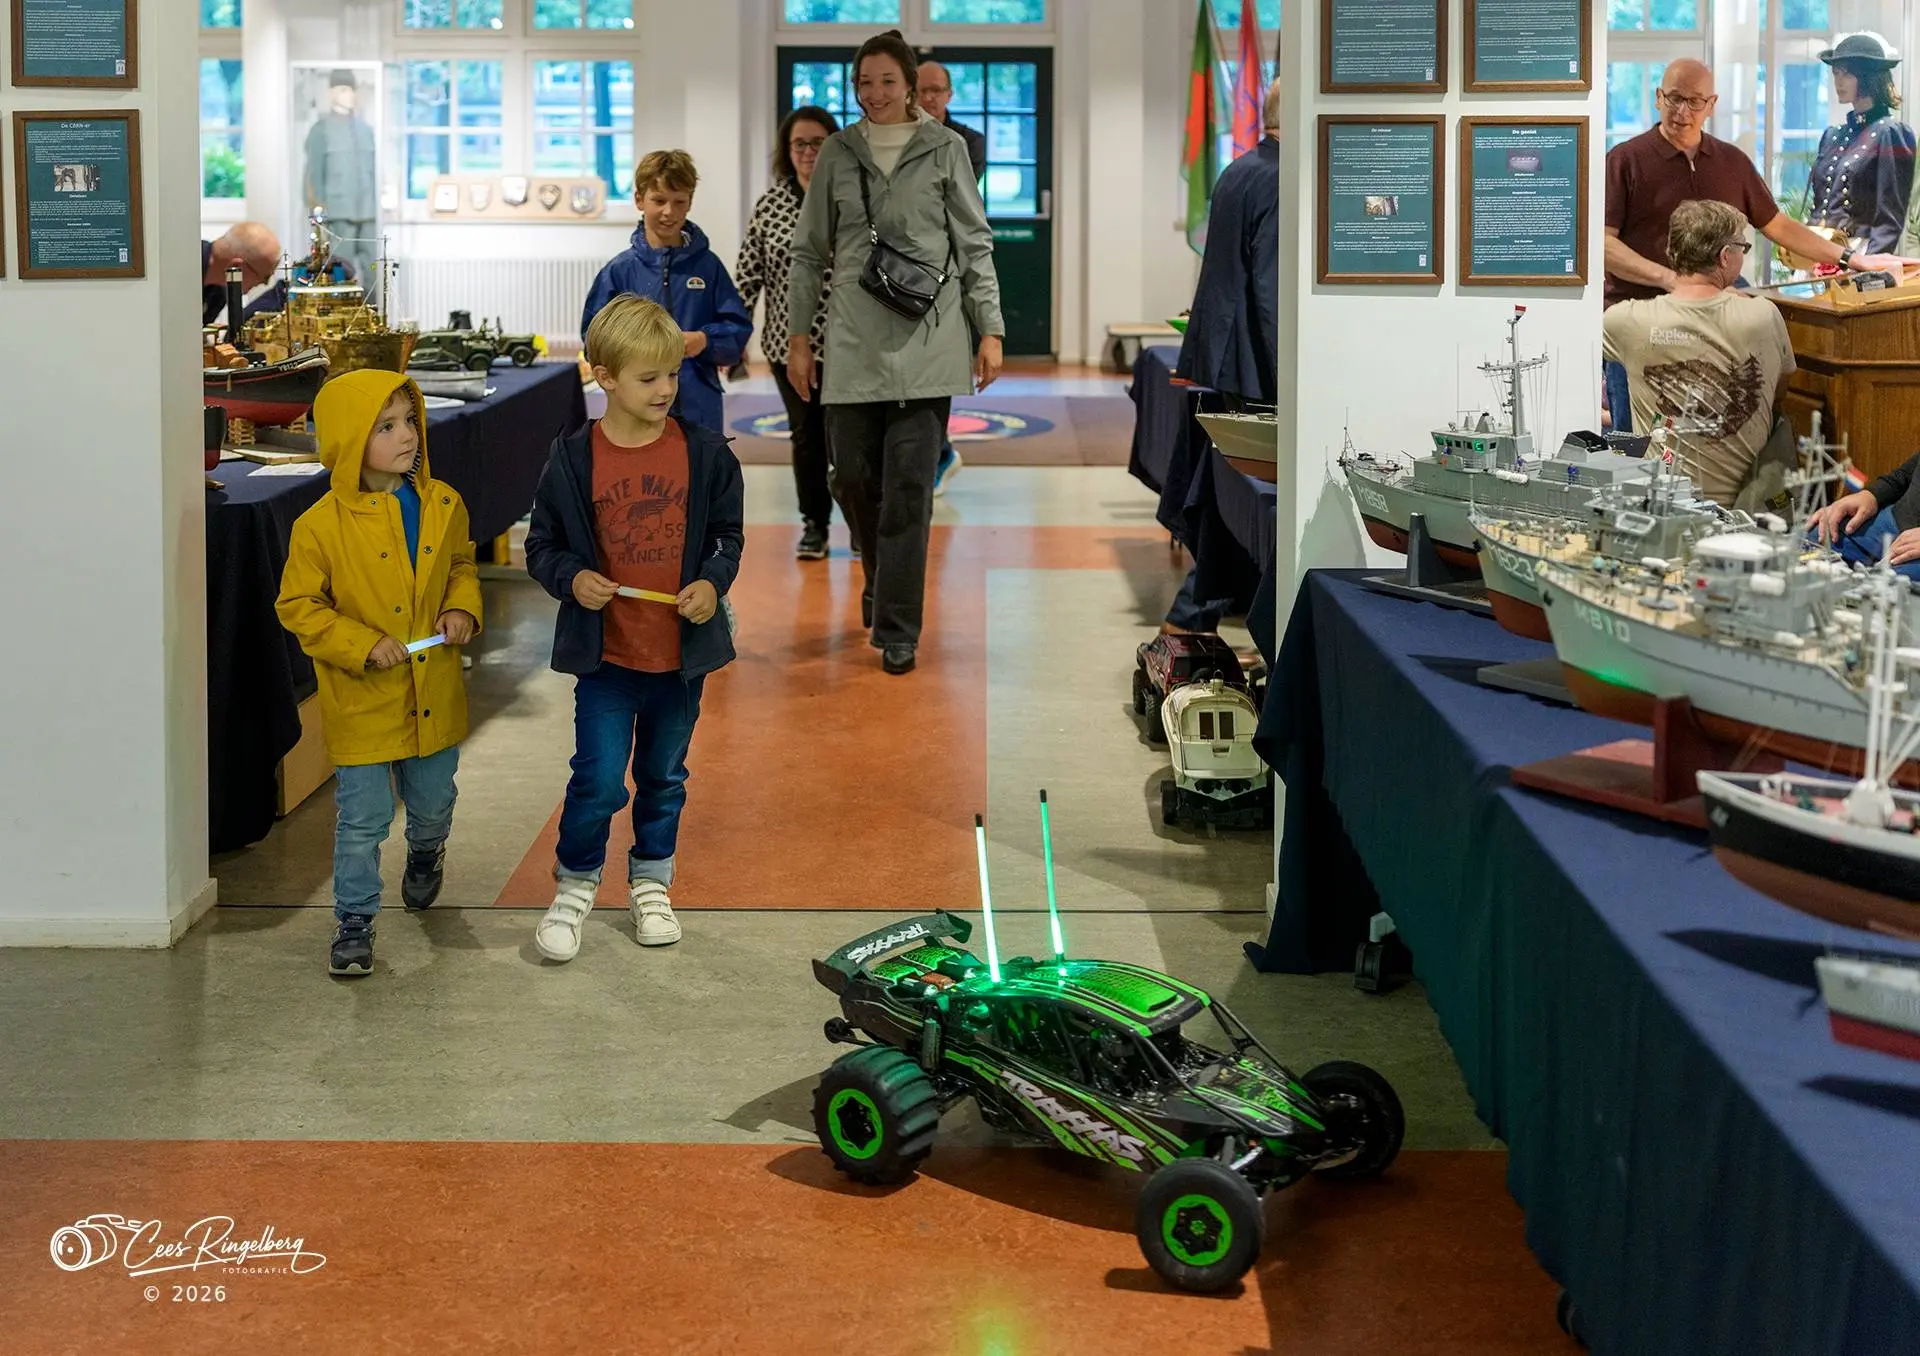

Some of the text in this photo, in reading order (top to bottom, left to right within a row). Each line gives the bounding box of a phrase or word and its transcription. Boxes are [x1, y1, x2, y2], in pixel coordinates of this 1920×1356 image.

[670, 545, 685, 560] C
[847, 923, 930, 964] TRAXXAS
[1001, 1070, 1147, 1162] TRAXXAS
